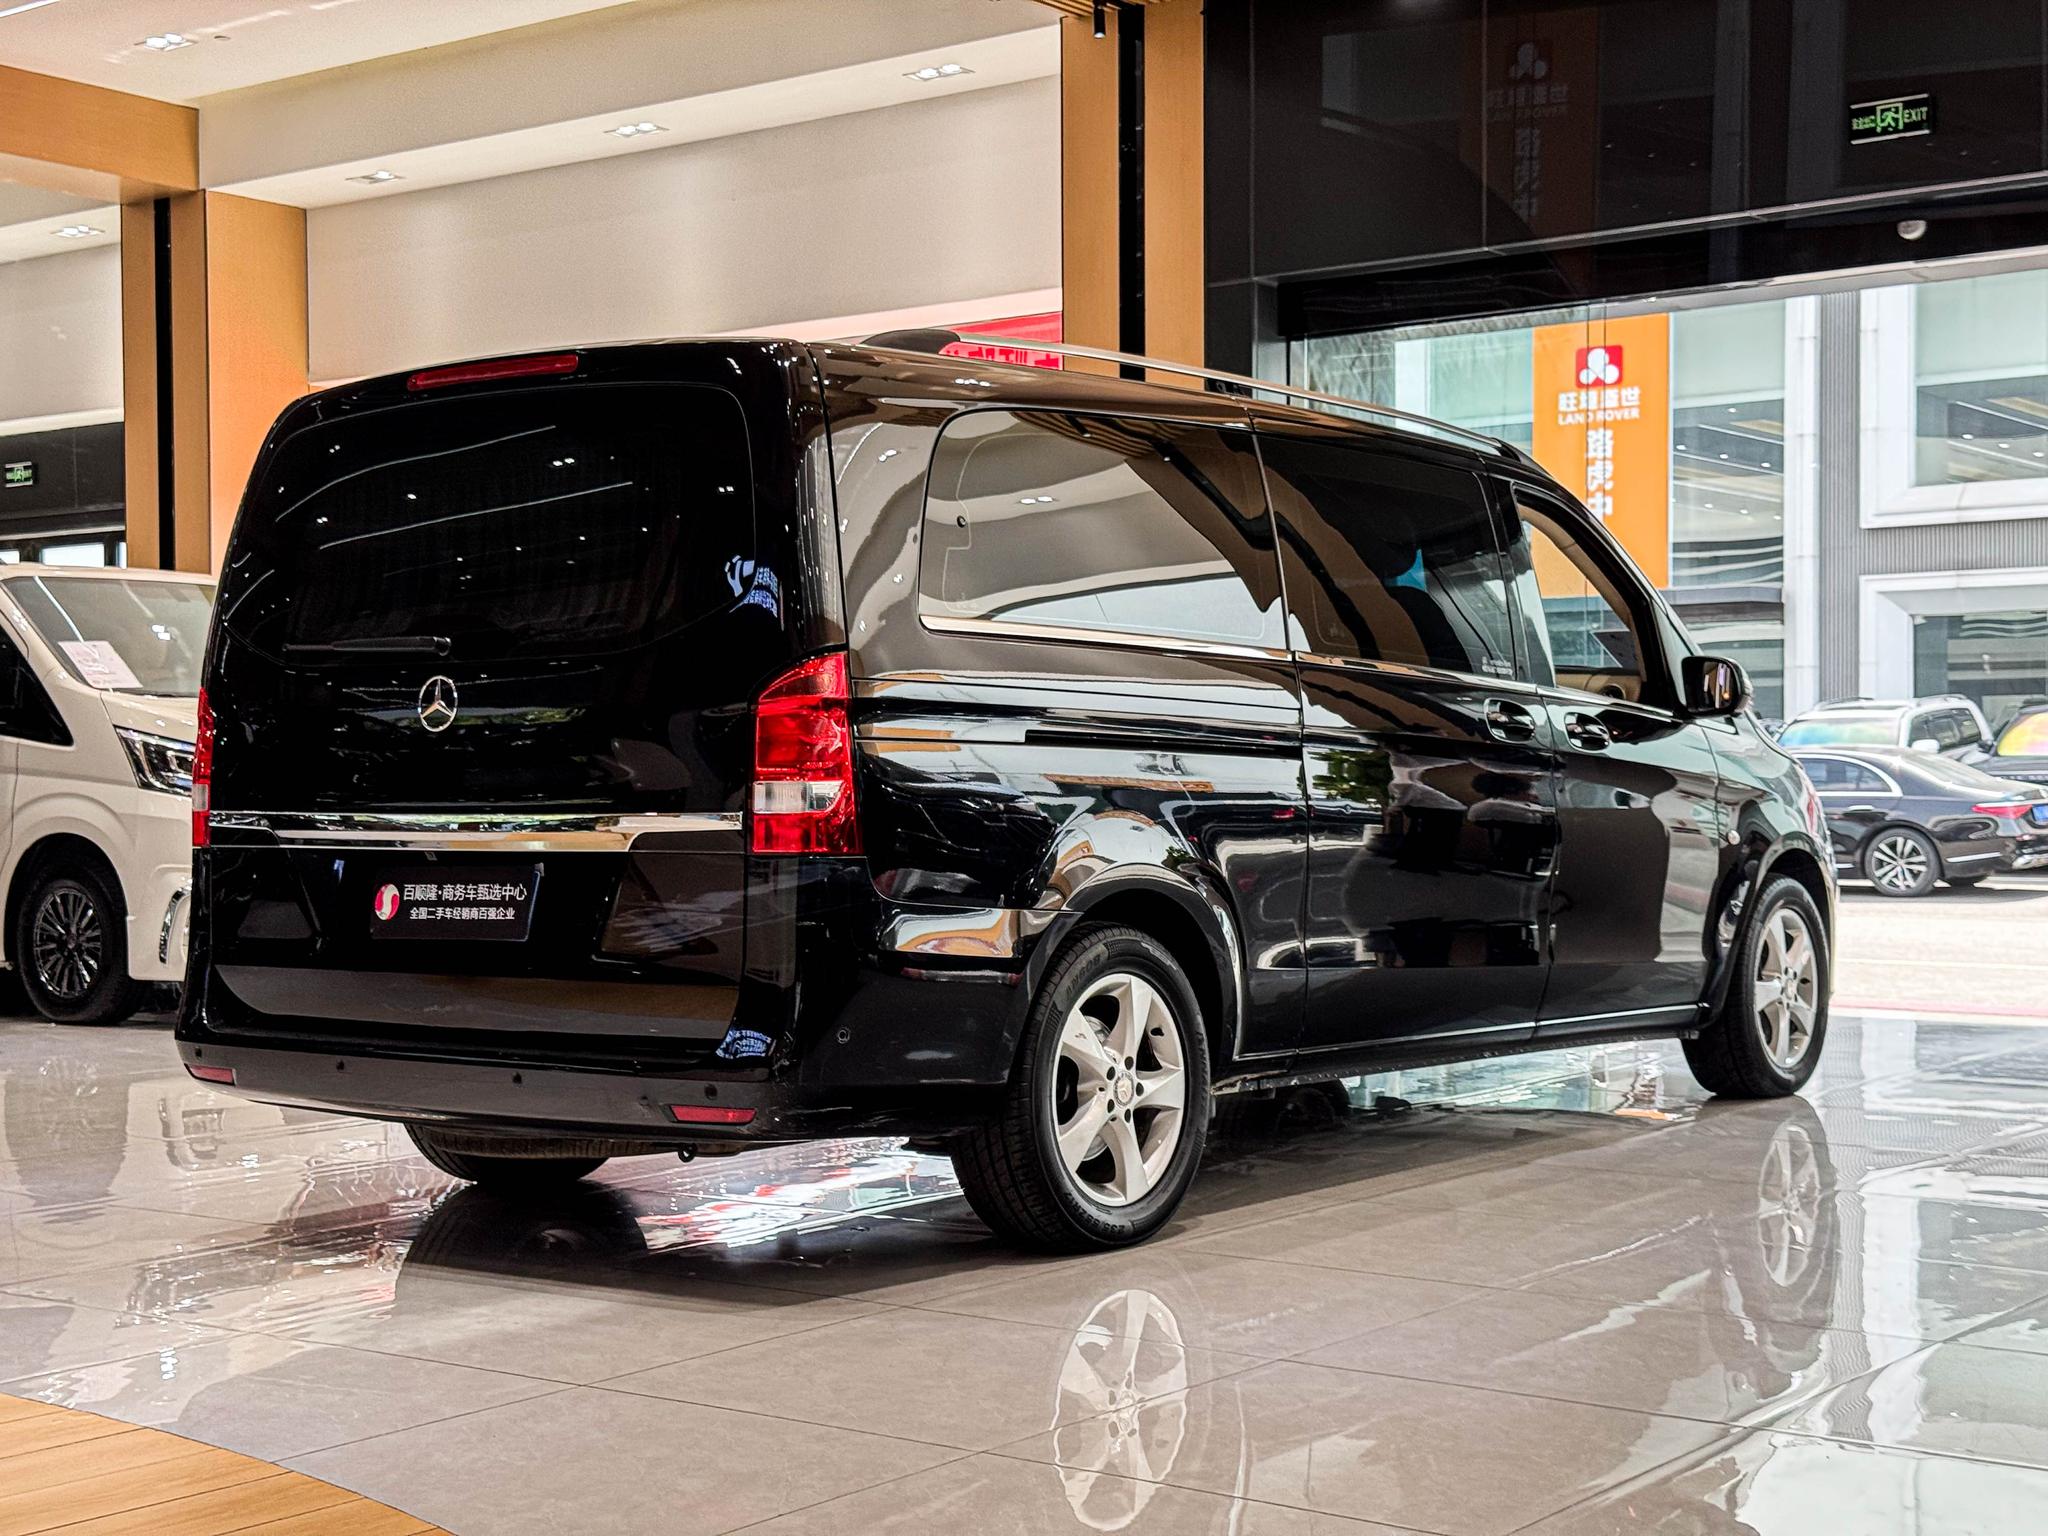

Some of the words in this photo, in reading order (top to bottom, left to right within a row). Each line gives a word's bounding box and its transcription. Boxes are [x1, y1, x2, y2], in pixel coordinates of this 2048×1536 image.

[1903, 107, 1928, 123] EXIT
[1558, 412, 1594, 425] LAND
[1596, 408, 1640, 421] ROVER
[410, 907, 515, 920] 全国二手车经销商百强企业
